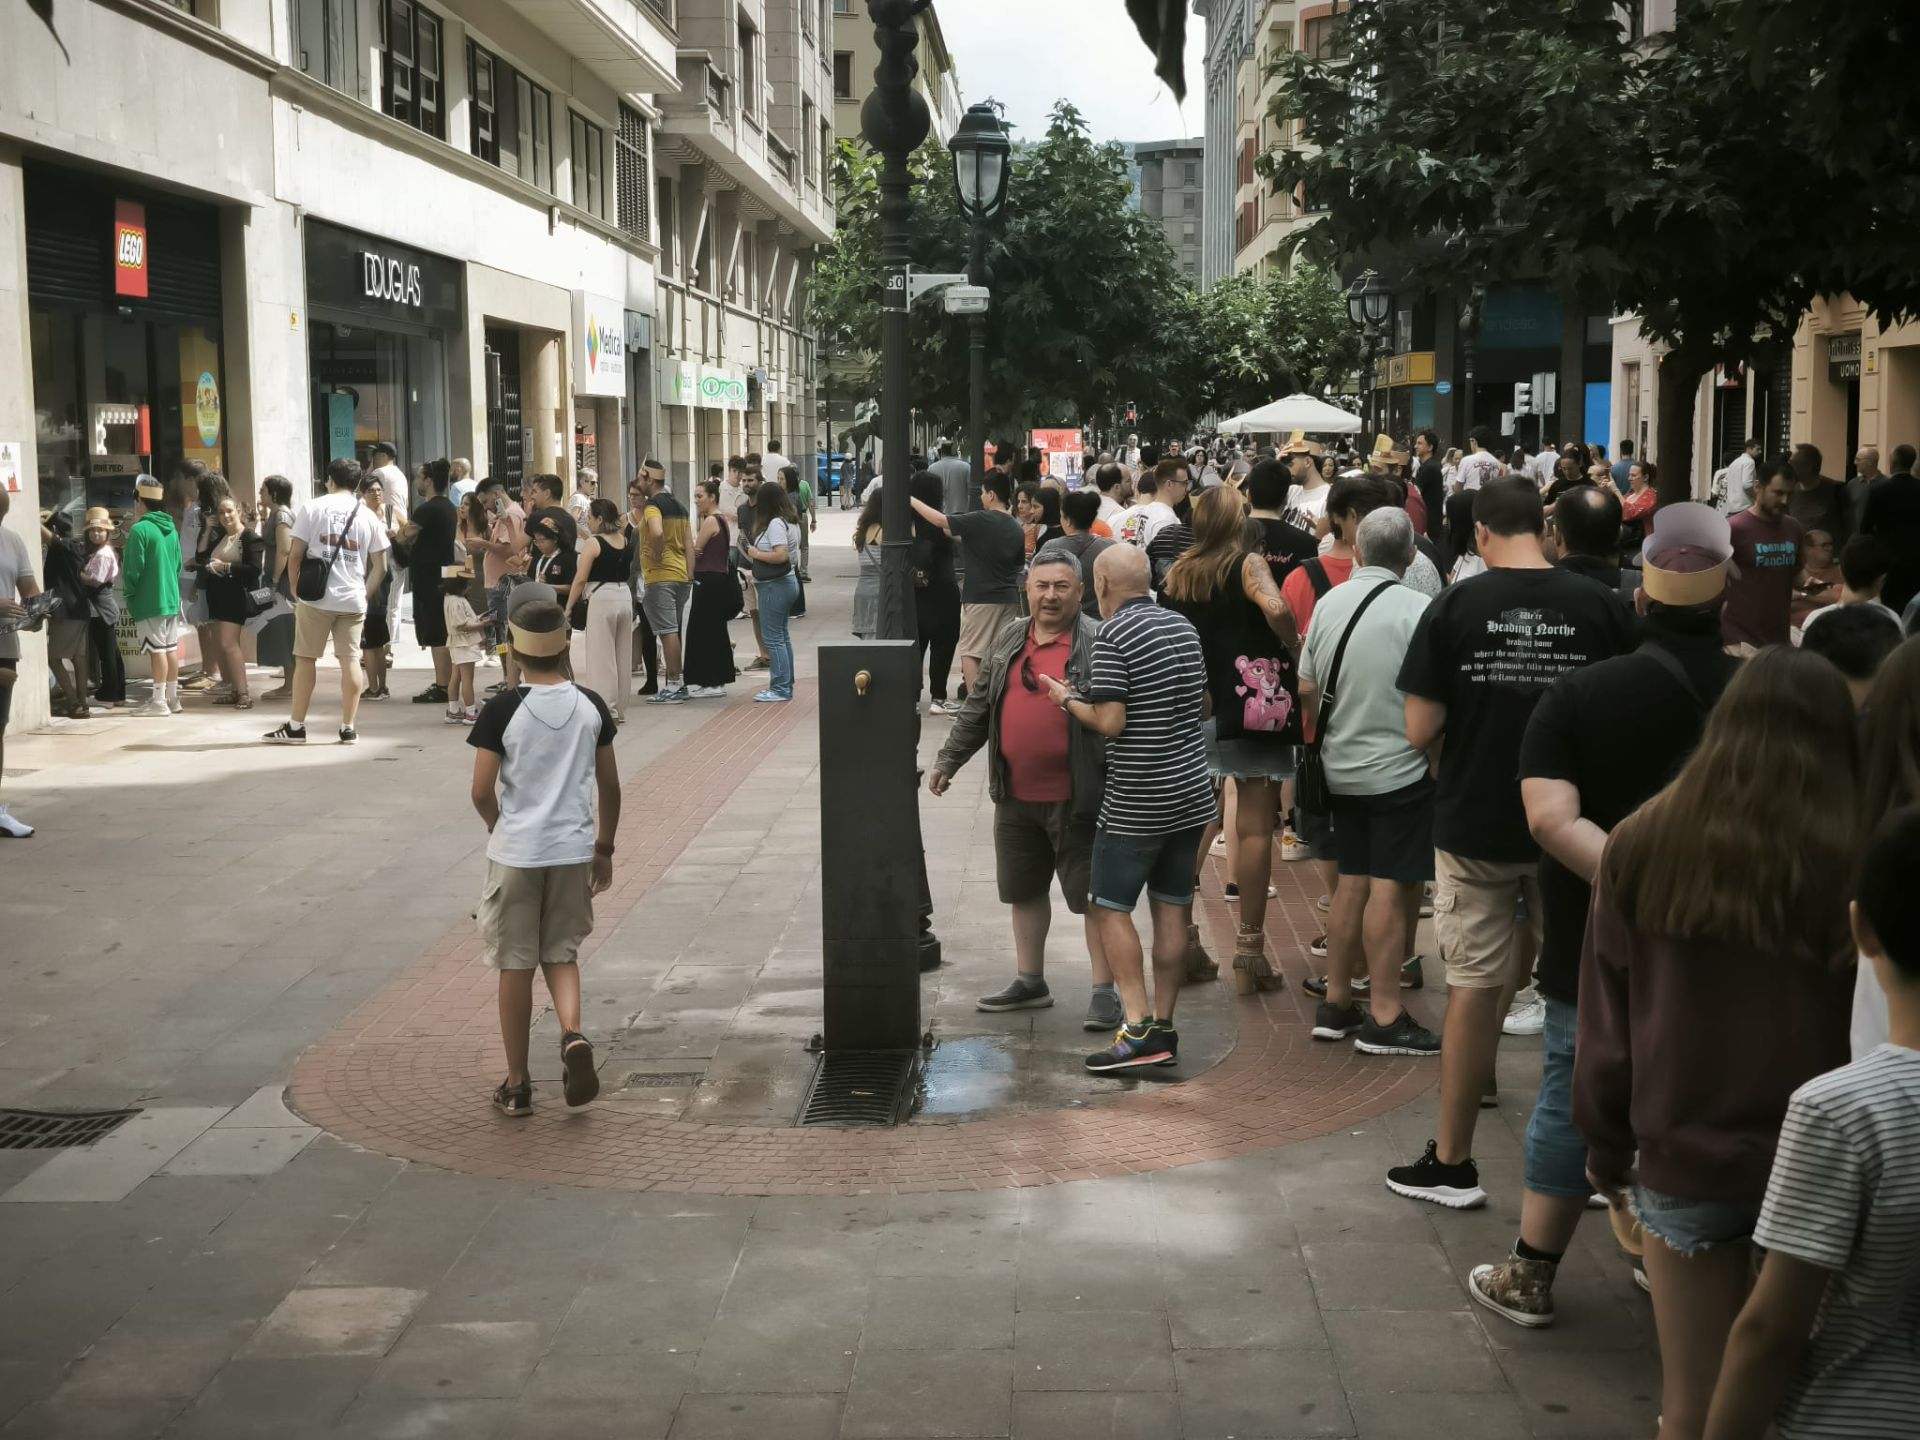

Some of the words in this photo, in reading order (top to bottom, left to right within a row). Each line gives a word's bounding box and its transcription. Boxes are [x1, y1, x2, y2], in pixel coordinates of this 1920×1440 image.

[119, 232, 142, 266] LEGO
[364, 251, 421, 307] DOUGLAS
[599, 325, 623, 357] Medical
[1828, 340, 1861, 357] intimiss
[1840, 363, 1860, 378] UOMO
[1486, 620, 1532, 636] Heading
[1534, 623, 1576, 638] Northe
